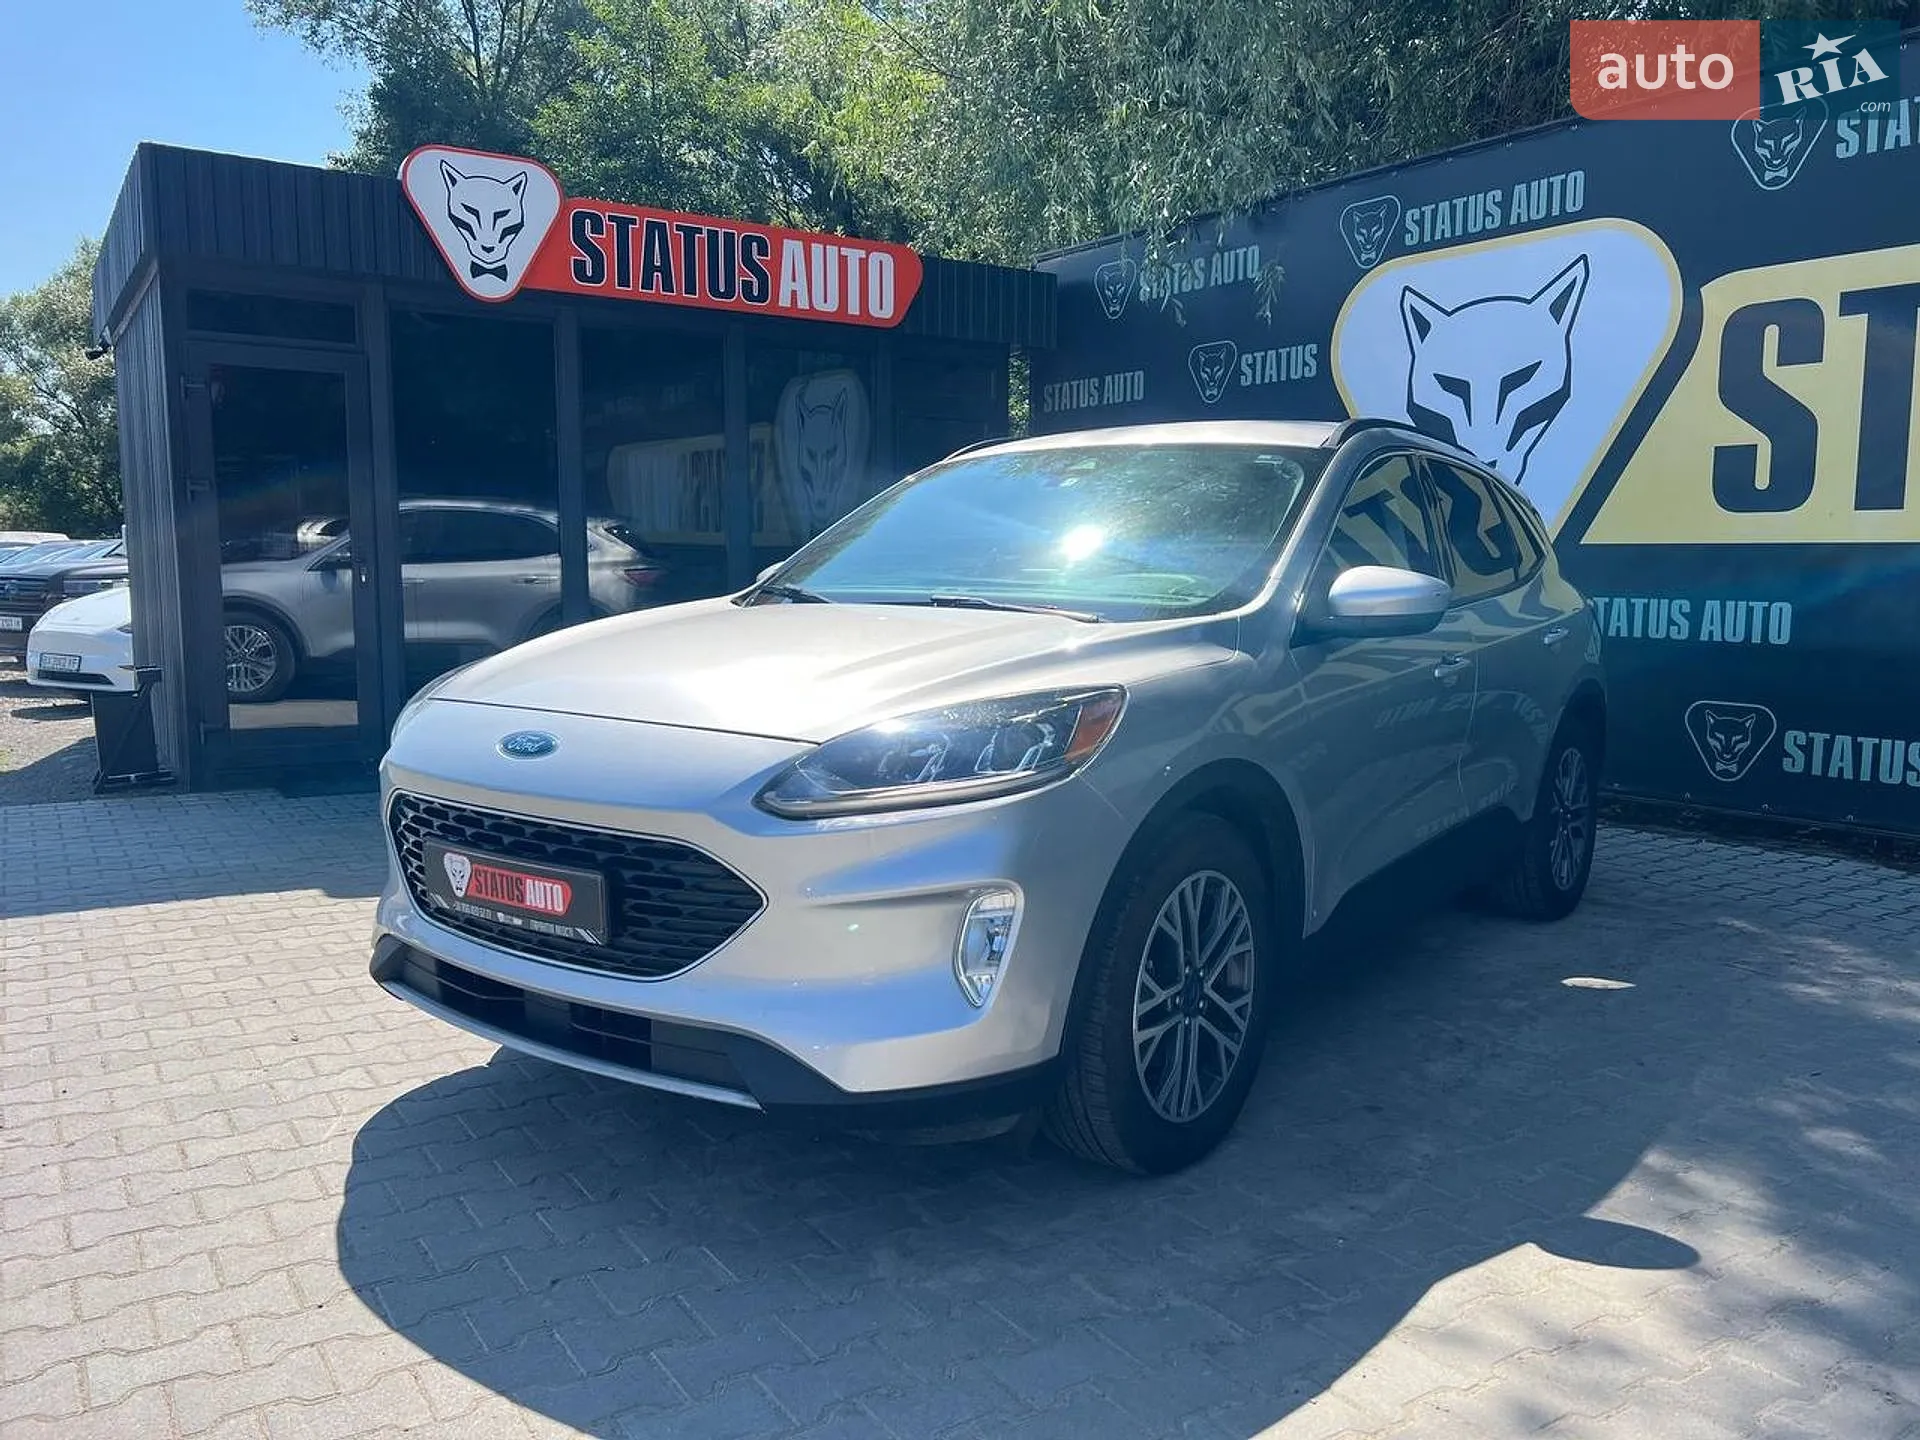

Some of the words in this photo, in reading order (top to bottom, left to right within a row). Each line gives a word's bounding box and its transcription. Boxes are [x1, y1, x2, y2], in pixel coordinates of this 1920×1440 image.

[1836, 96, 1920, 159] STA
[1405, 188, 1502, 246] STATUS
[1509, 170, 1585, 225] AUTO
[570, 209, 770, 304] STATUS
[779, 239, 895, 320] AUTO
[1210, 245, 1260, 287] AUTO
[1239, 344, 1318, 386] STATUS
[1044, 377, 1101, 413] STATUS
[1103, 370, 1144, 404] AUTO
[1588, 597, 1691, 640] TATUS
[1699, 600, 1793, 645] AUTO
[474, 872, 525, 903] STATUS
[526, 879, 563, 911] AUTO
